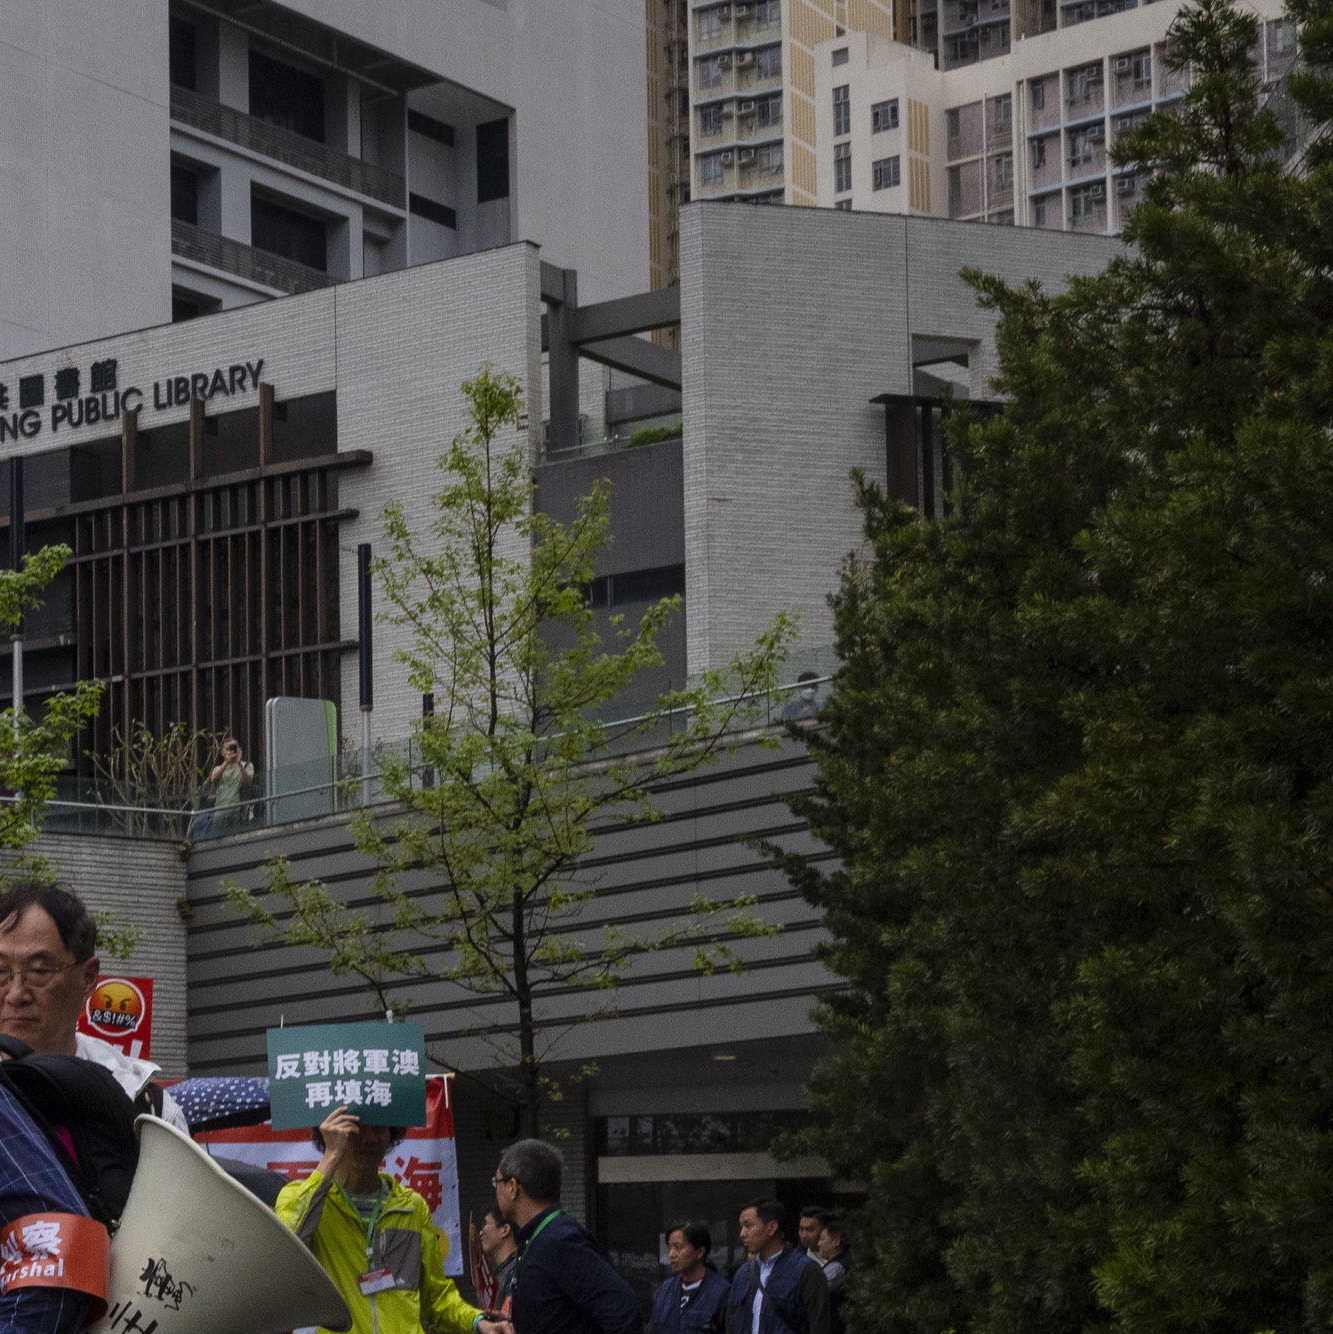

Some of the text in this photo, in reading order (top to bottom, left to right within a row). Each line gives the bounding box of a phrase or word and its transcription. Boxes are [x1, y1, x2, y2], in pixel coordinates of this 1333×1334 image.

[51, 387, 143, 432] PUBLIC
[153, 358, 264, 411] LIBRARY
[275, 1048, 420, 1081] 反對將軍澳
[305, 1079, 392, 1109] 再填海
